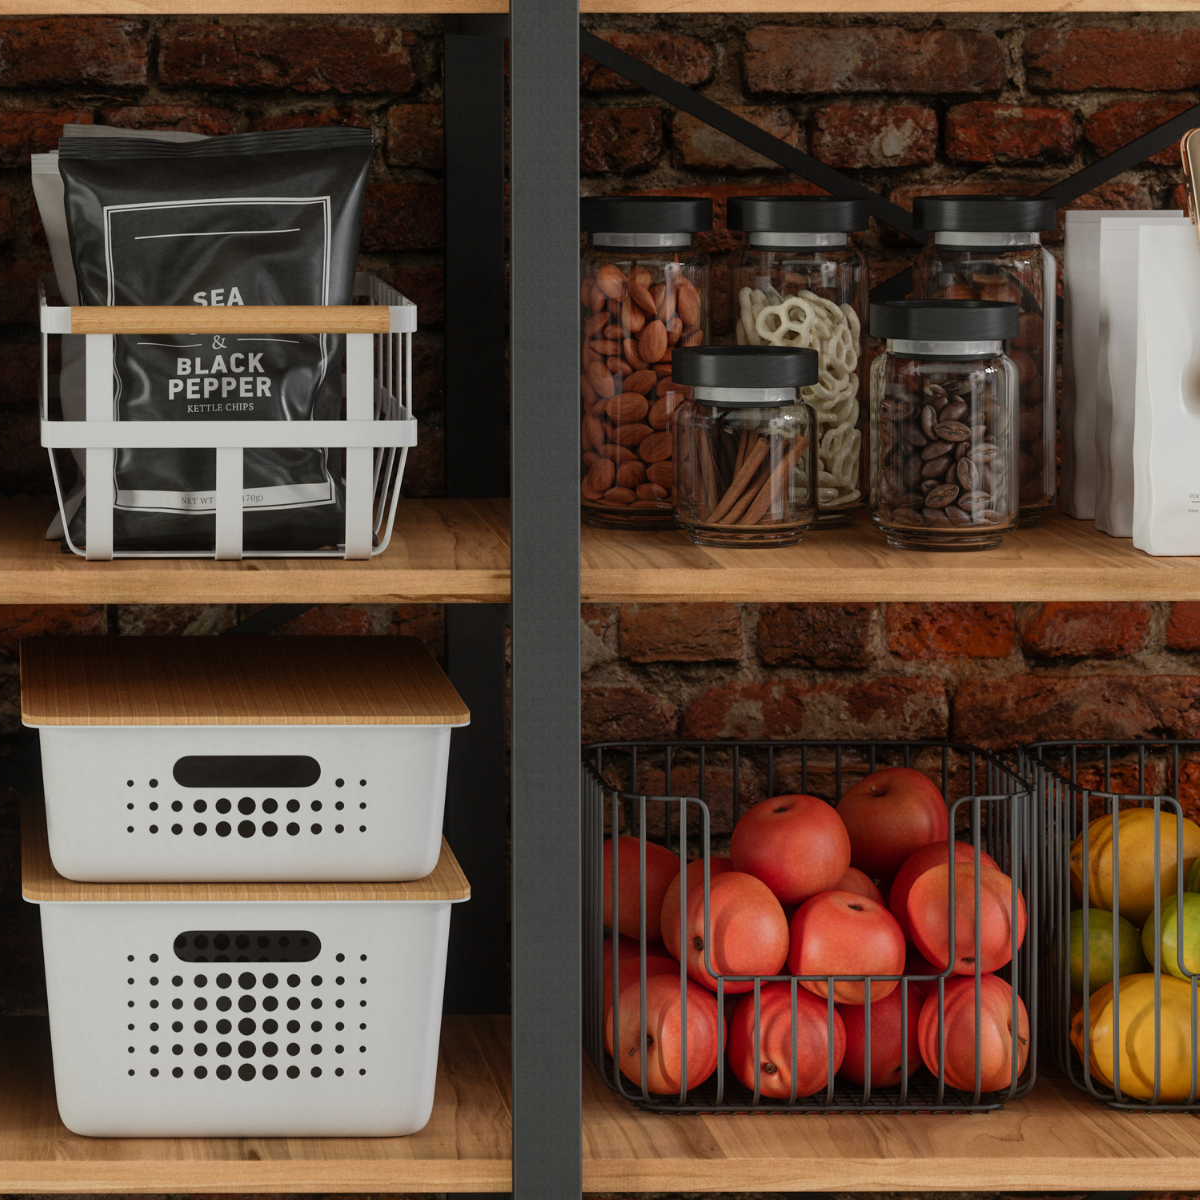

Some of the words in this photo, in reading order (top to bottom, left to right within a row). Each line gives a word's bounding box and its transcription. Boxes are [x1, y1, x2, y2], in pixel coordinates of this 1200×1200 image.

[193, 286, 244, 306] SEA
[212, 335, 227, 350] &
[177, 352, 265, 375] BLACK
[168, 377, 272, 400] PEPPER
[187, 403, 223, 413] KETTLE
[225, 402, 254, 411] CHIPS
